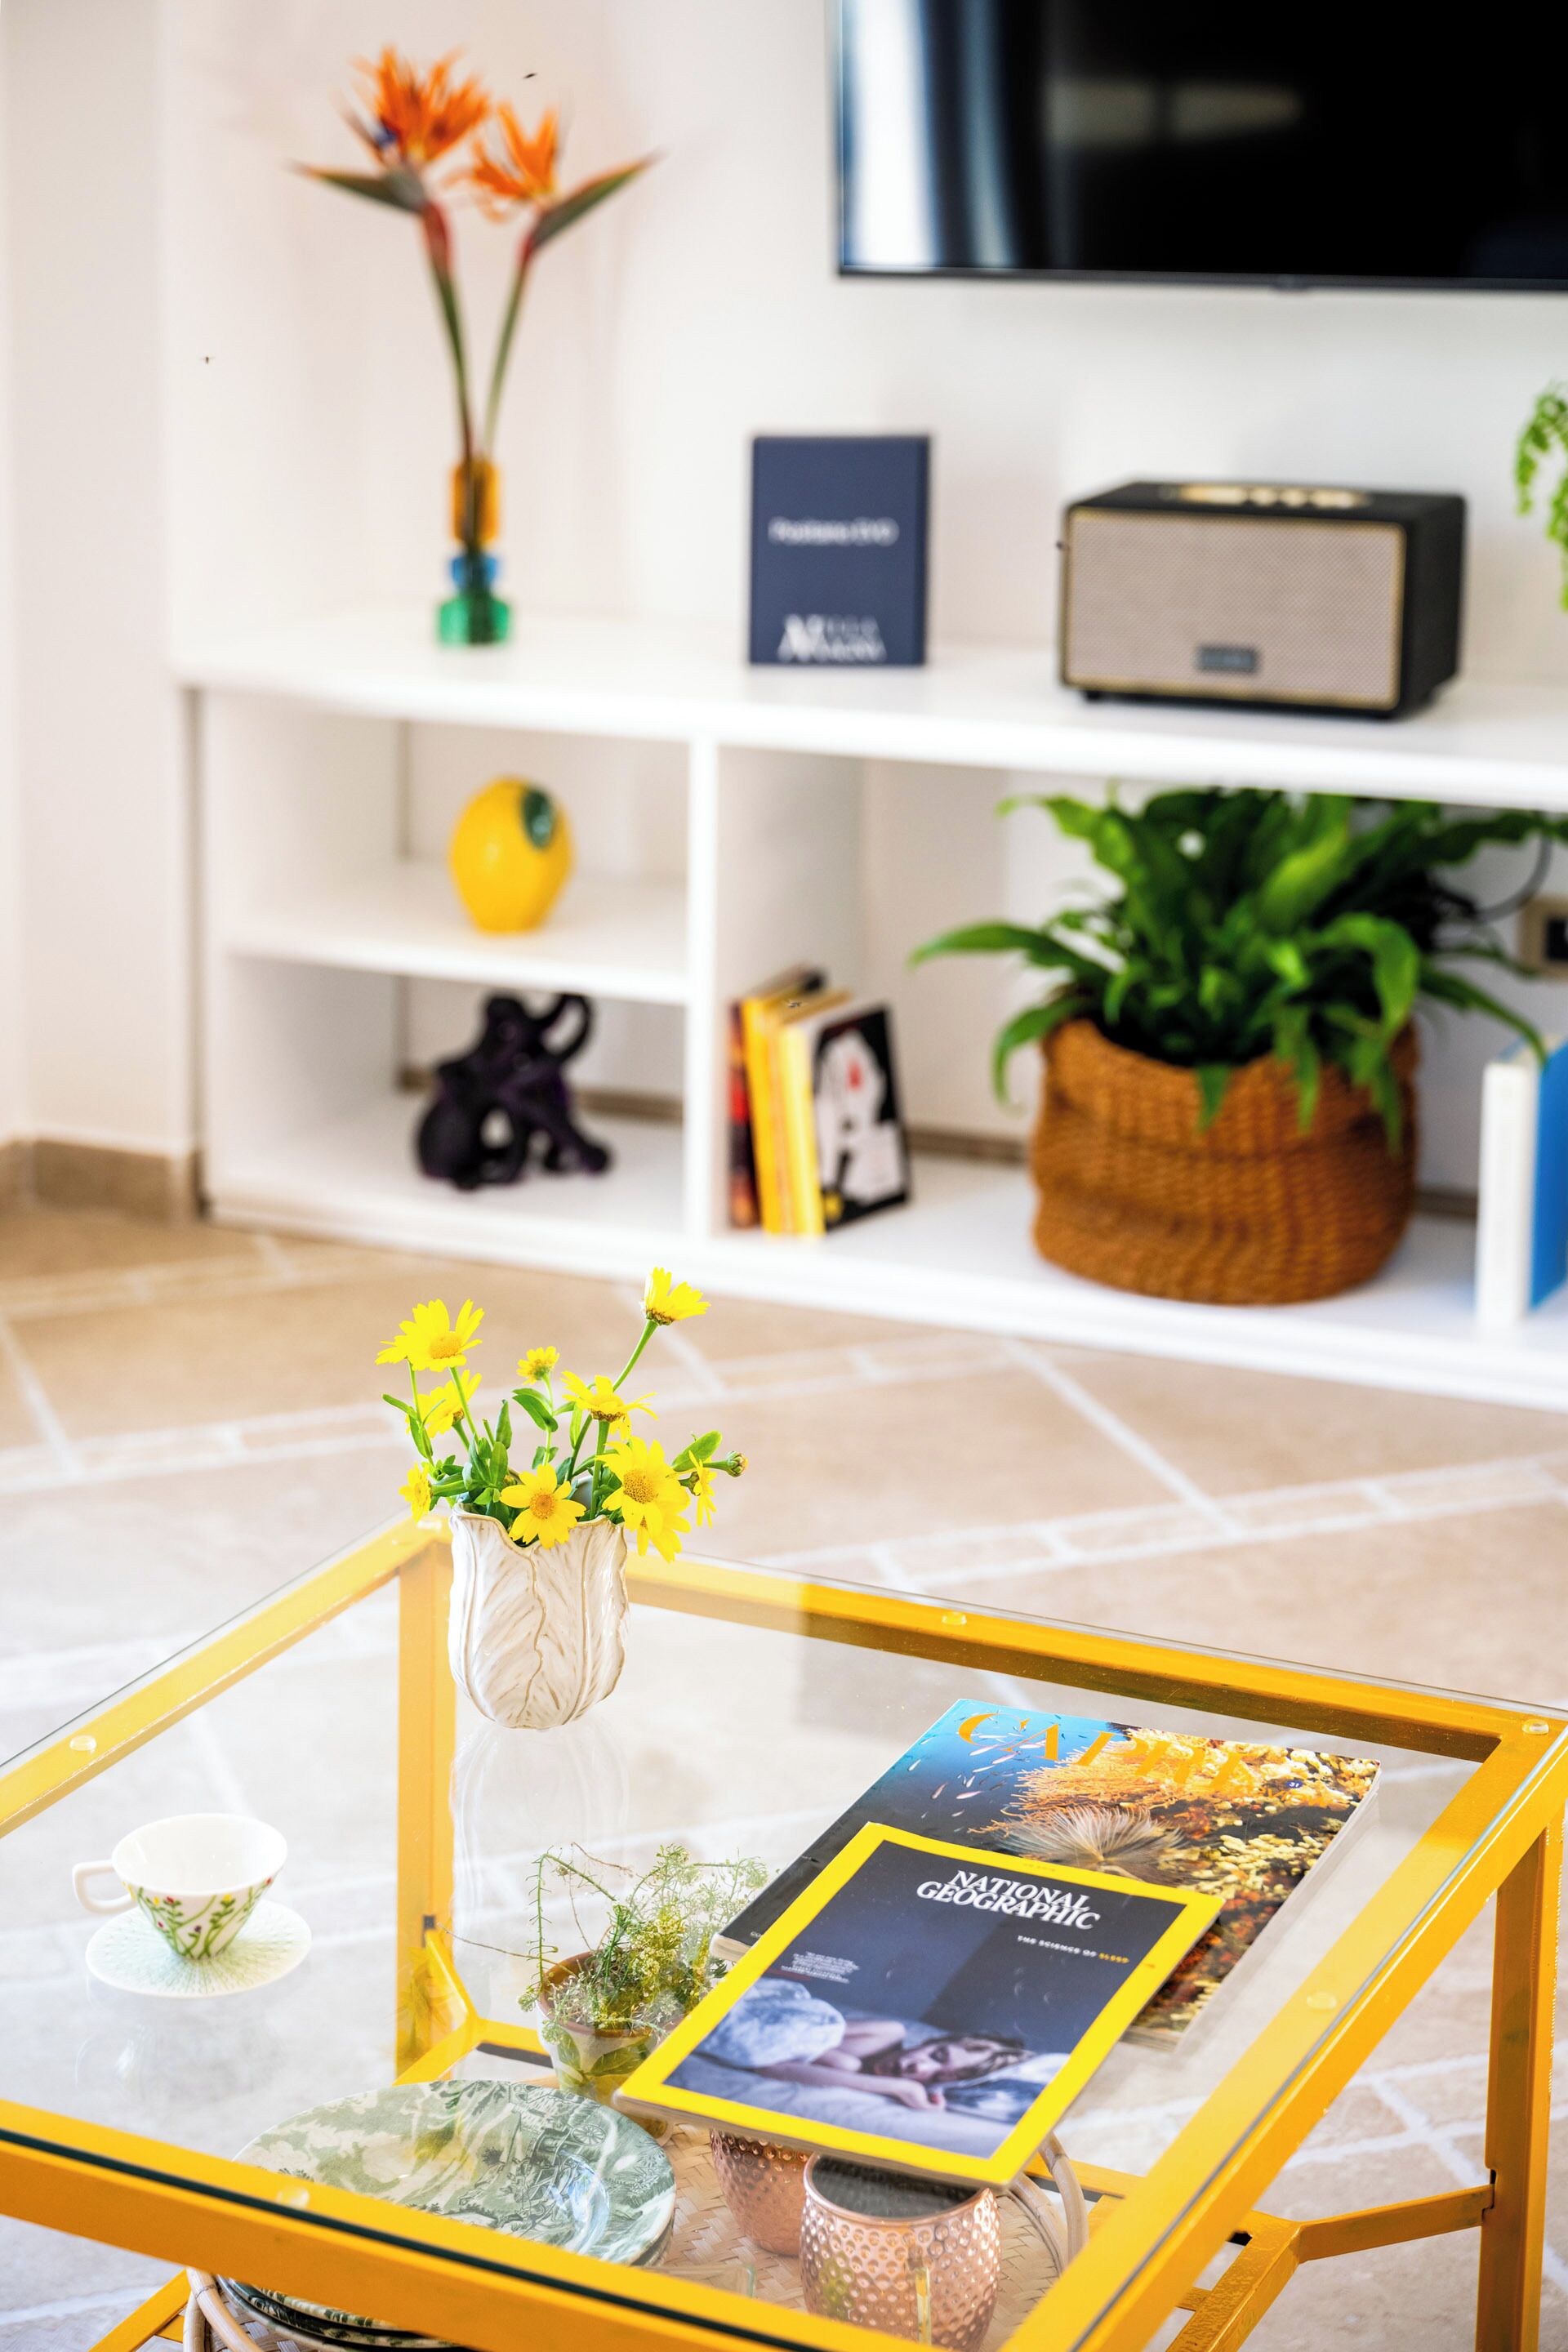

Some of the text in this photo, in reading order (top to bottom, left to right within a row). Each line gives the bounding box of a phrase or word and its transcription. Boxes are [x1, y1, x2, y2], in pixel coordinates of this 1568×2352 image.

[957, 1713, 1245, 1791] CAPRI
[915, 1881, 1102, 1931] GEOGRAPHIC
[947, 1869, 1092, 1913] NATIONAL
[1038, 1939, 1081, 1955] SCIENCE
